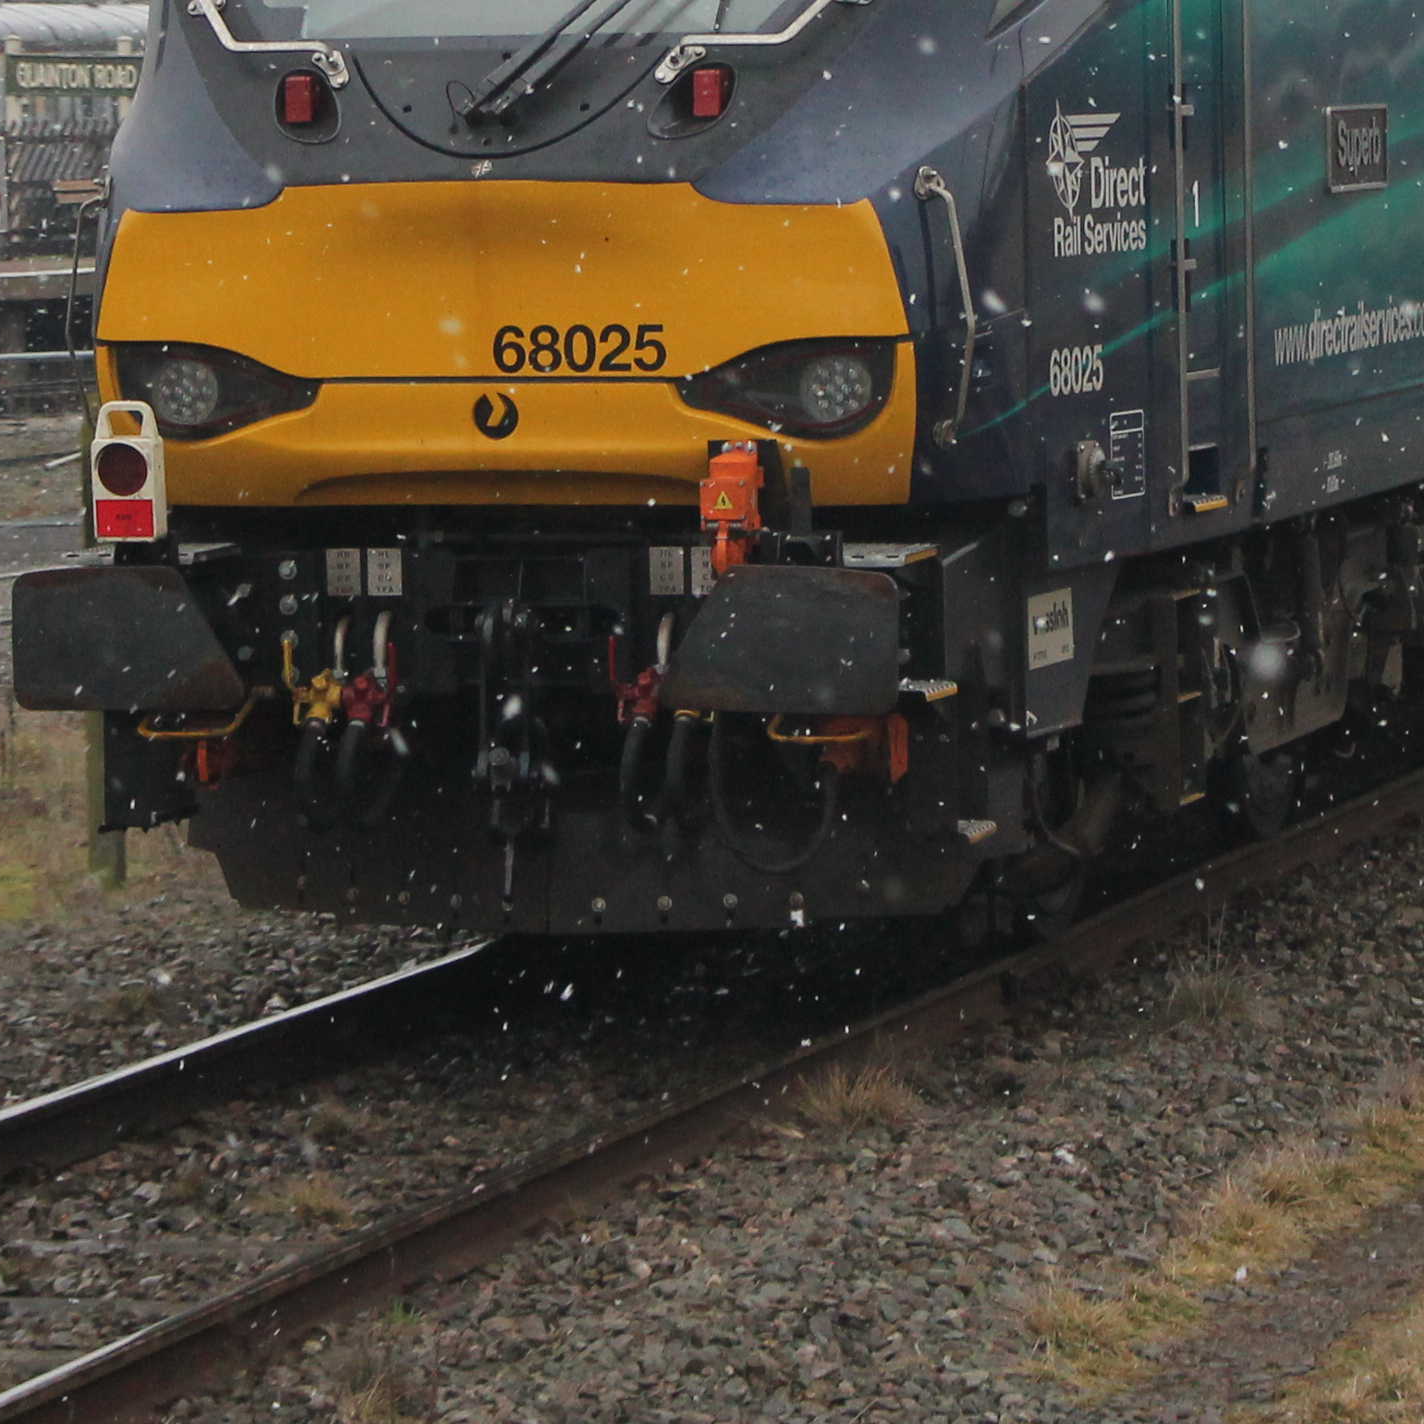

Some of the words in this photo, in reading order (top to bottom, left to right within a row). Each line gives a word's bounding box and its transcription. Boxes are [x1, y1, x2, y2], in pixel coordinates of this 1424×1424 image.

[94, 64, 137, 89] ROAD
[1338, 116, 1382, 177] Superb
[1091, 156, 1146, 208] Direct
[1054, 216, 1080, 257] Rail
[1084, 212, 1147, 255] Services
[493, 324, 666, 373] 68025
[1050, 344, 1104, 396] 68025
